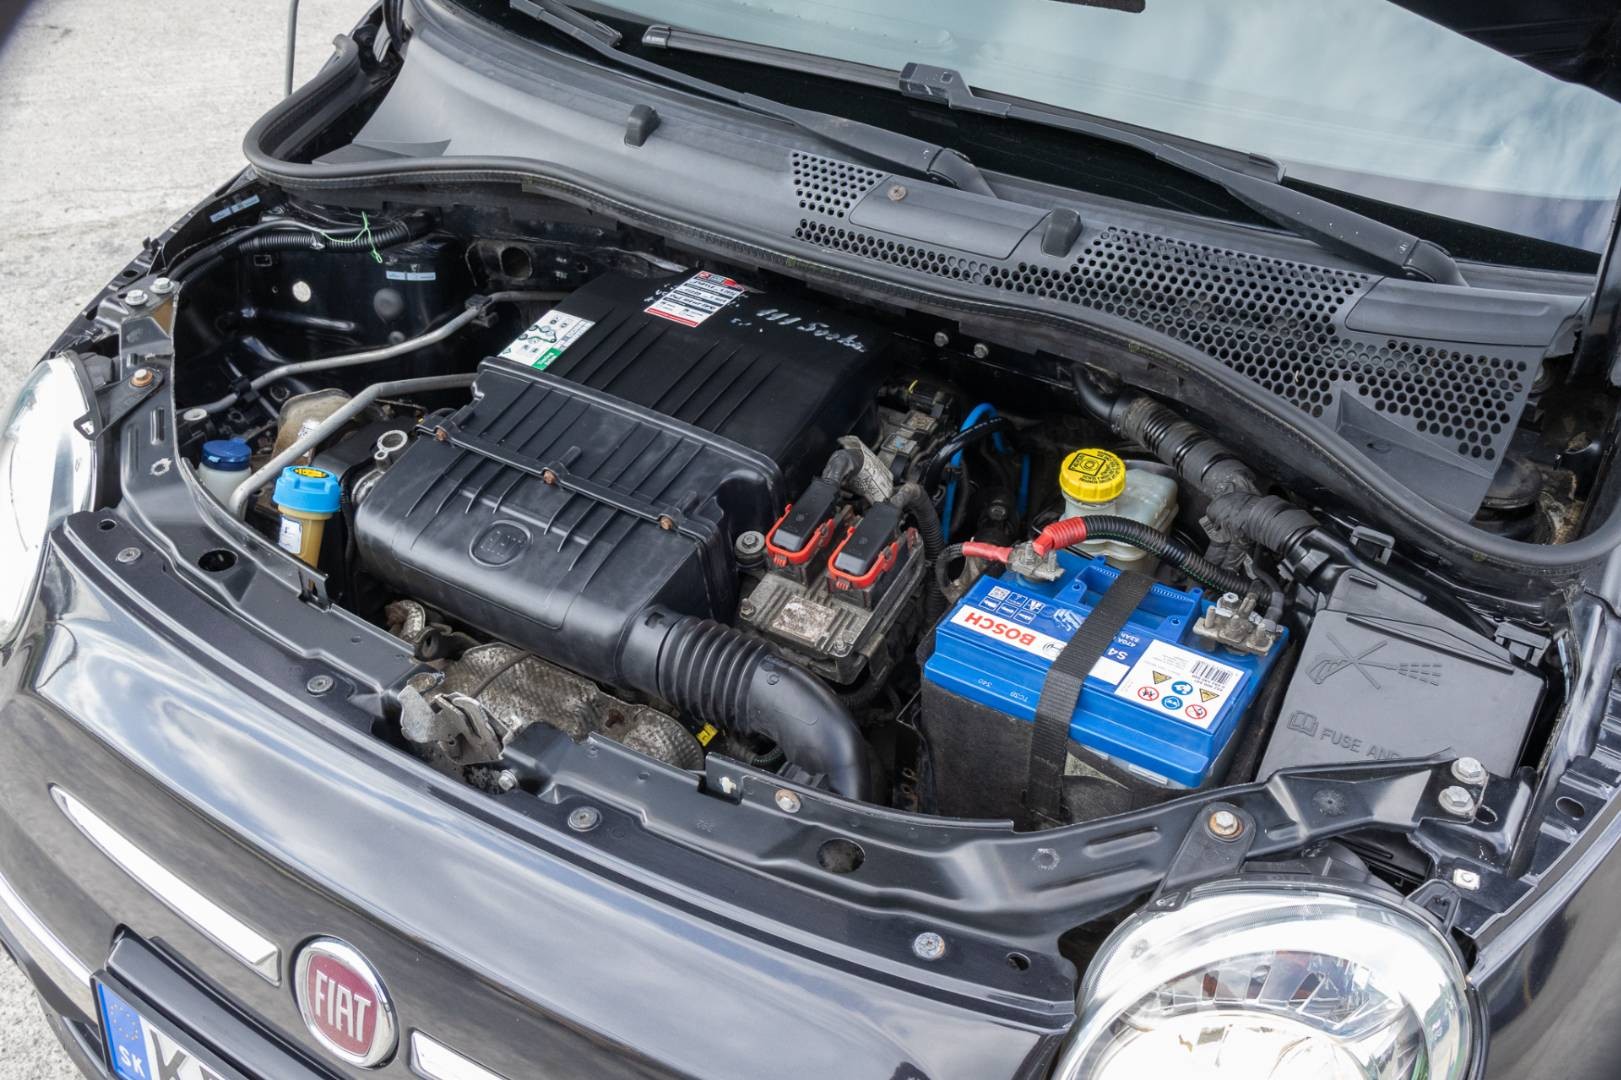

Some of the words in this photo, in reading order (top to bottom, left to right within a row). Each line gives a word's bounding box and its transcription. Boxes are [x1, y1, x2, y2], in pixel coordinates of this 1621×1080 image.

[964, 612, 1037, 646] BOSCH
[1107, 646, 1128, 660] S4
[1320, 727, 1363, 753] FUSE
[314, 968, 371, 1043] FIAT
[118, 1045, 145, 1078] SK
